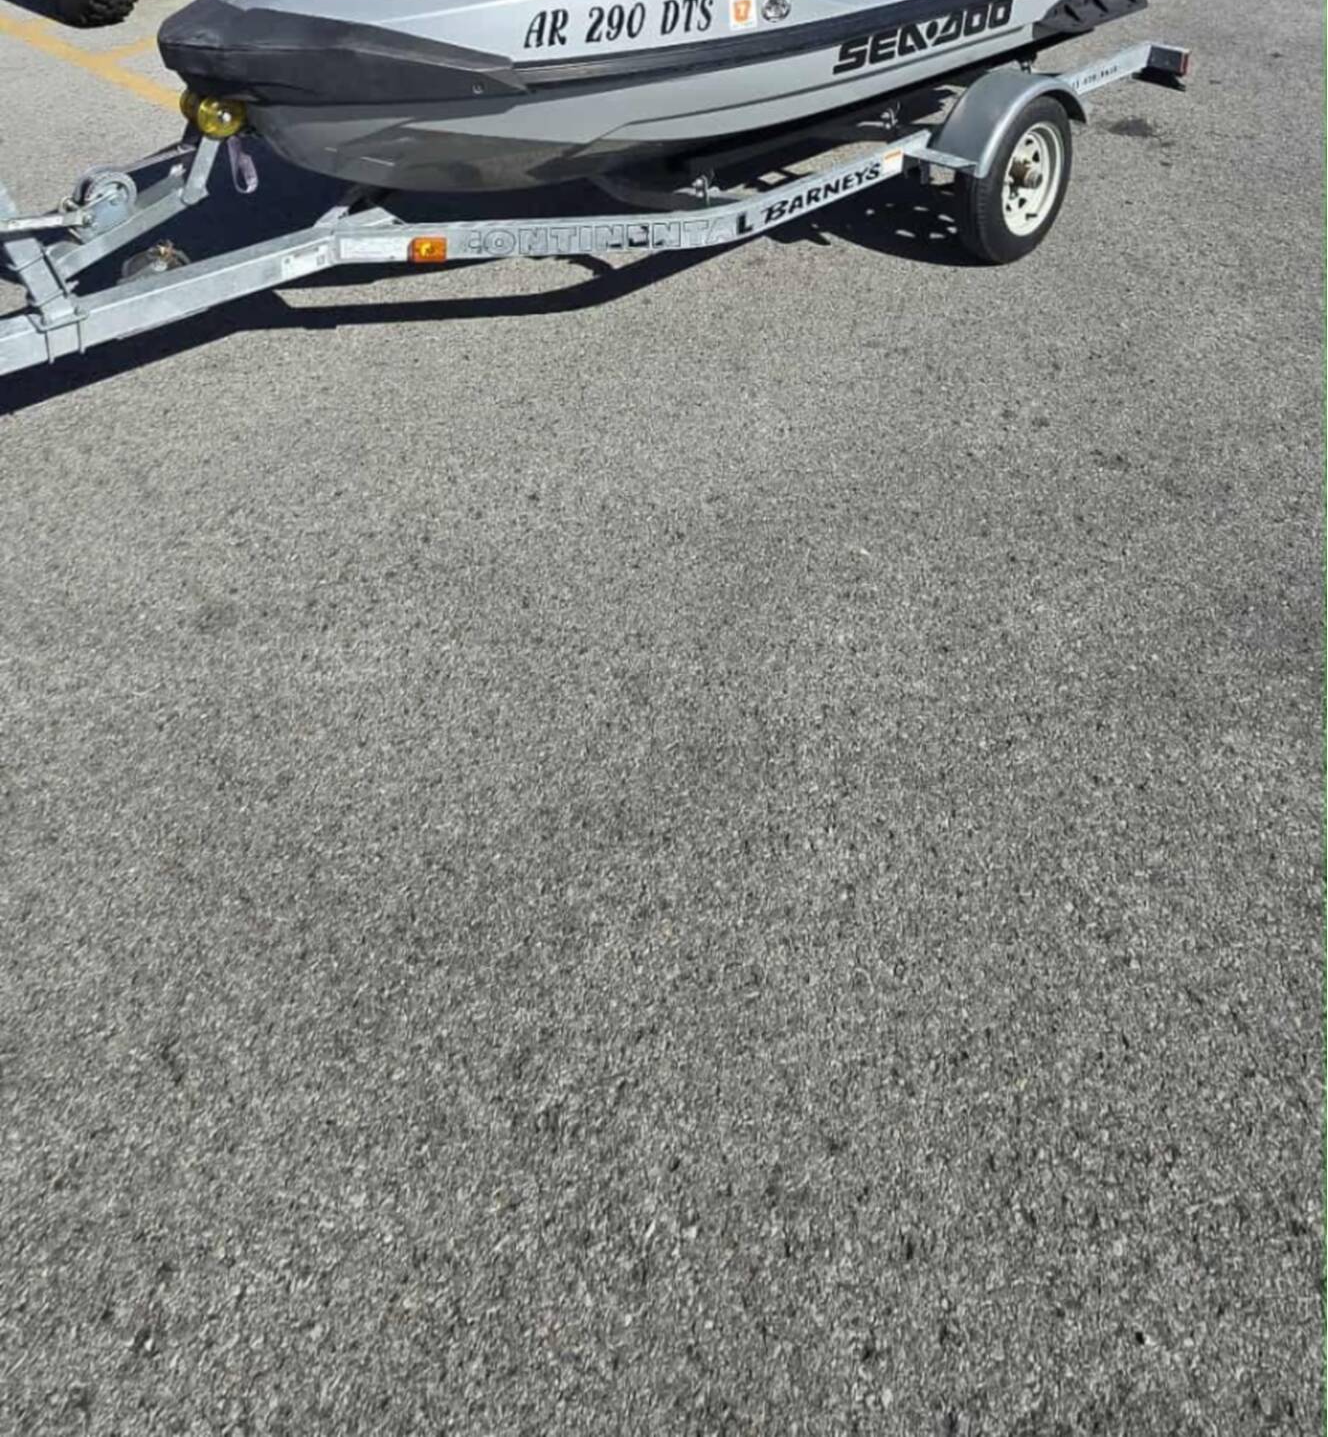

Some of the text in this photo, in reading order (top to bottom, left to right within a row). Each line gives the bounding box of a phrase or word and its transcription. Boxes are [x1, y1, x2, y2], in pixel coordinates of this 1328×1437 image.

[523, 8, 569, 49] AR
[584, 1, 646, 44] 290
[760, 162, 882, 225] BARNEYS
